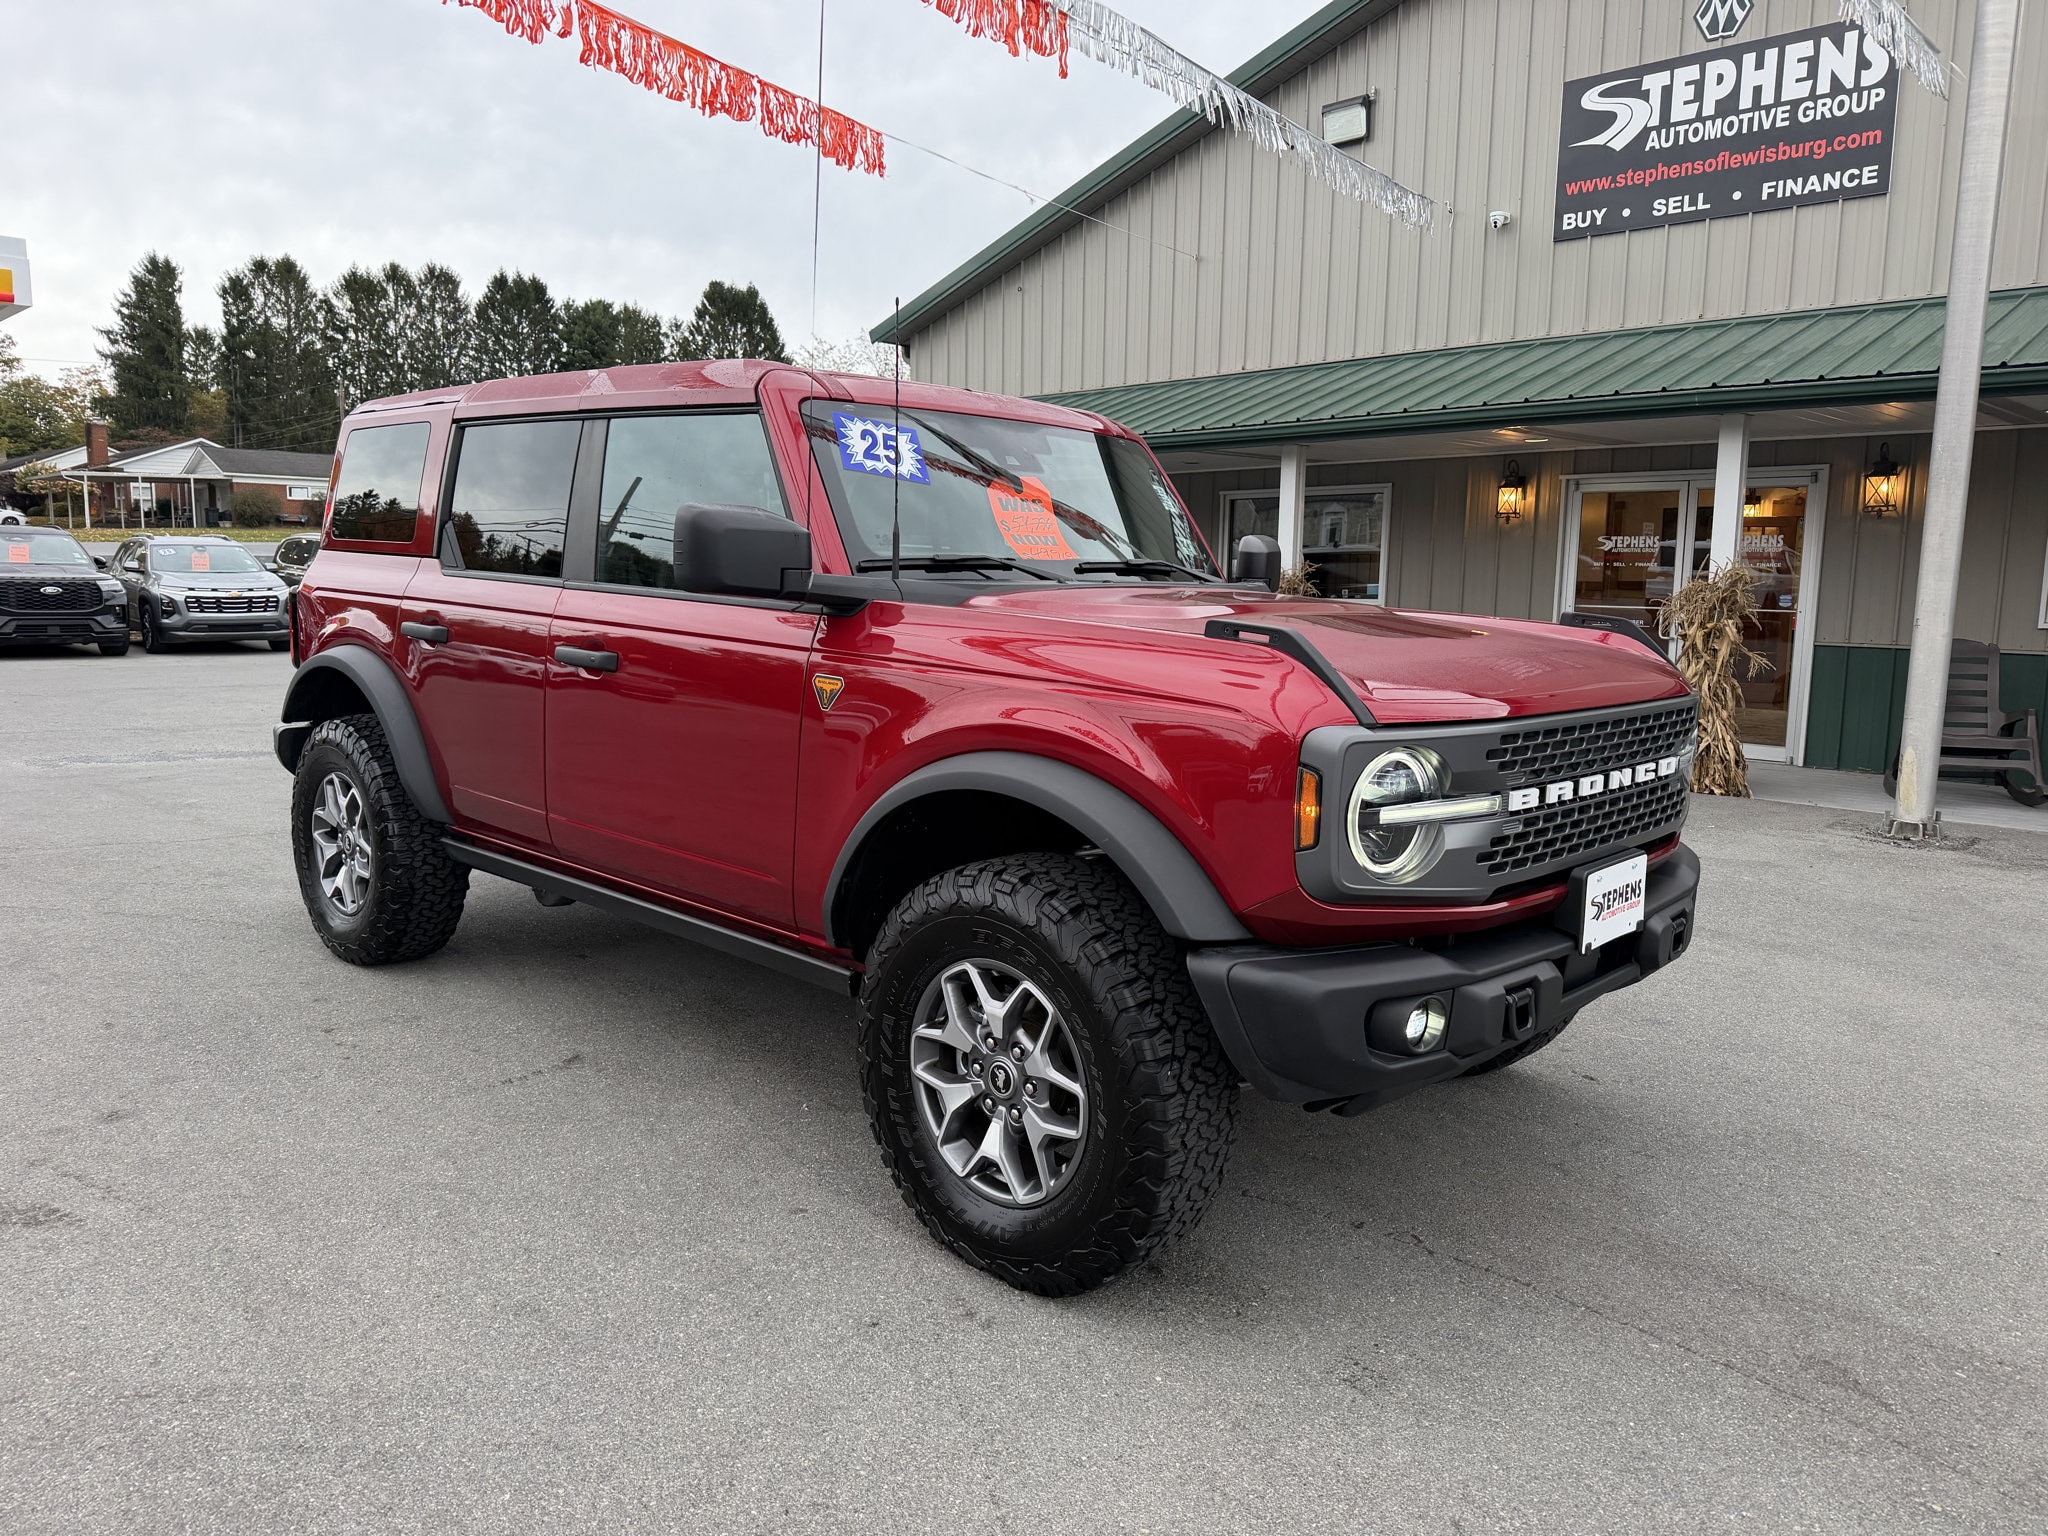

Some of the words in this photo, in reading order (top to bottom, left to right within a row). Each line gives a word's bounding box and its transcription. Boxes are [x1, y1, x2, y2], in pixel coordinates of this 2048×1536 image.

[1568, 29, 1890, 151] STEPHENS
[1644, 105, 1791, 151] AUTOMOTIVE
[1797, 87, 1886, 124] GROUP
[1565, 129, 1882, 196] www.stephensoflewisburg.com
[1562, 207, 1608, 231] BUY
[1652, 192, 1711, 217] SELL
[1761, 164, 1880, 200] FINANCE
[860, 428, 902, 466] 25
[997, 496, 1046, 513] WAS
[1010, 533, 1059, 547] NOW
[1595, 535, 1660, 551] STEPHENS
[1508, 756, 1678, 812] BRONCO
[1590, 878, 1642, 921] STEPHENS
[1601, 904, 1626, 922] AUTOMOTIVE
[1626, 899, 1641, 911] GROUP
